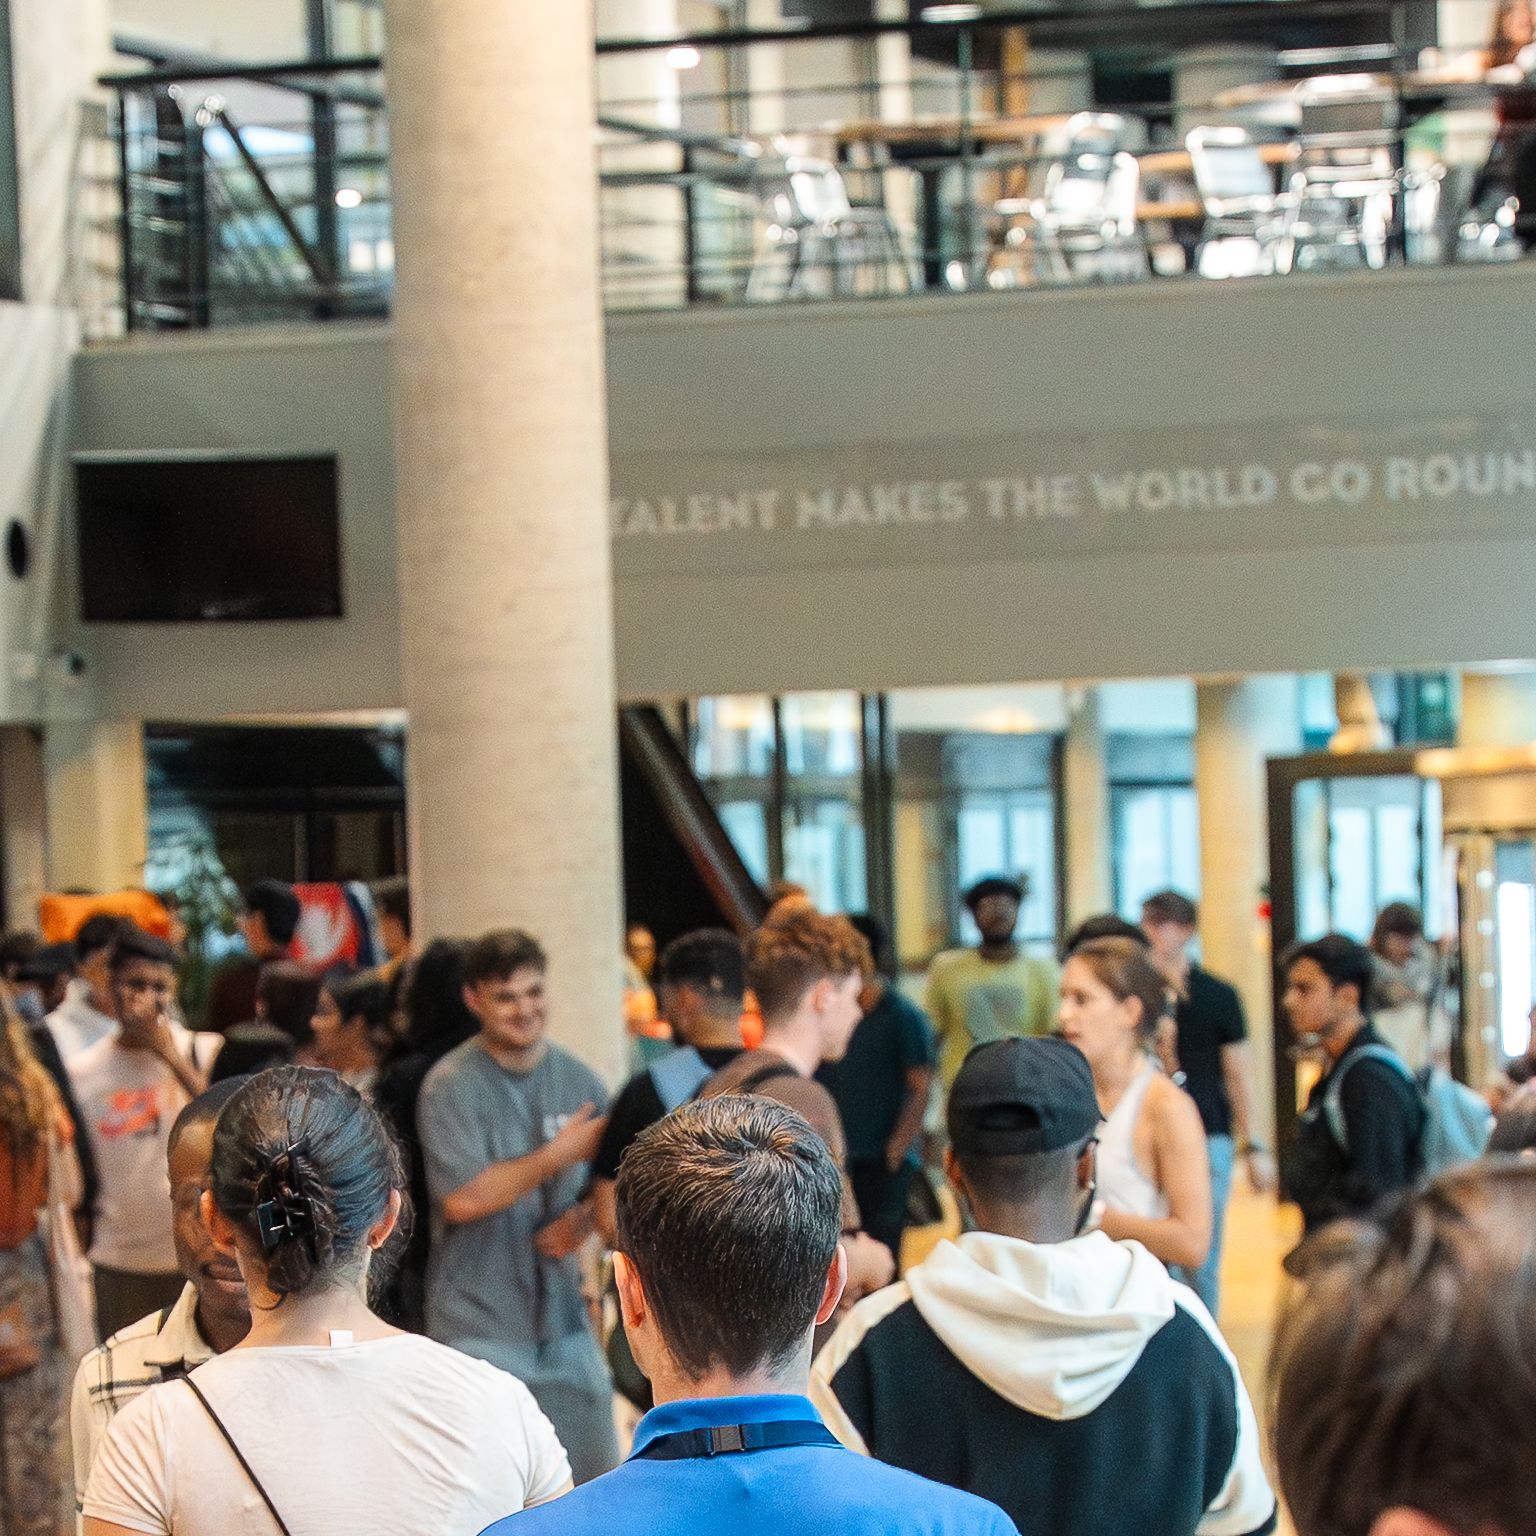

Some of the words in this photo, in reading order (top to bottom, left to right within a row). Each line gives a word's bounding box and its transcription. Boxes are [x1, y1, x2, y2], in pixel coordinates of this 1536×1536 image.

[795, 481, 968, 529] MAKES
[980, 475, 1080, 517] THE
[1090, 464, 1277, 510] WORLD
[1289, 460, 1371, 503] GO
